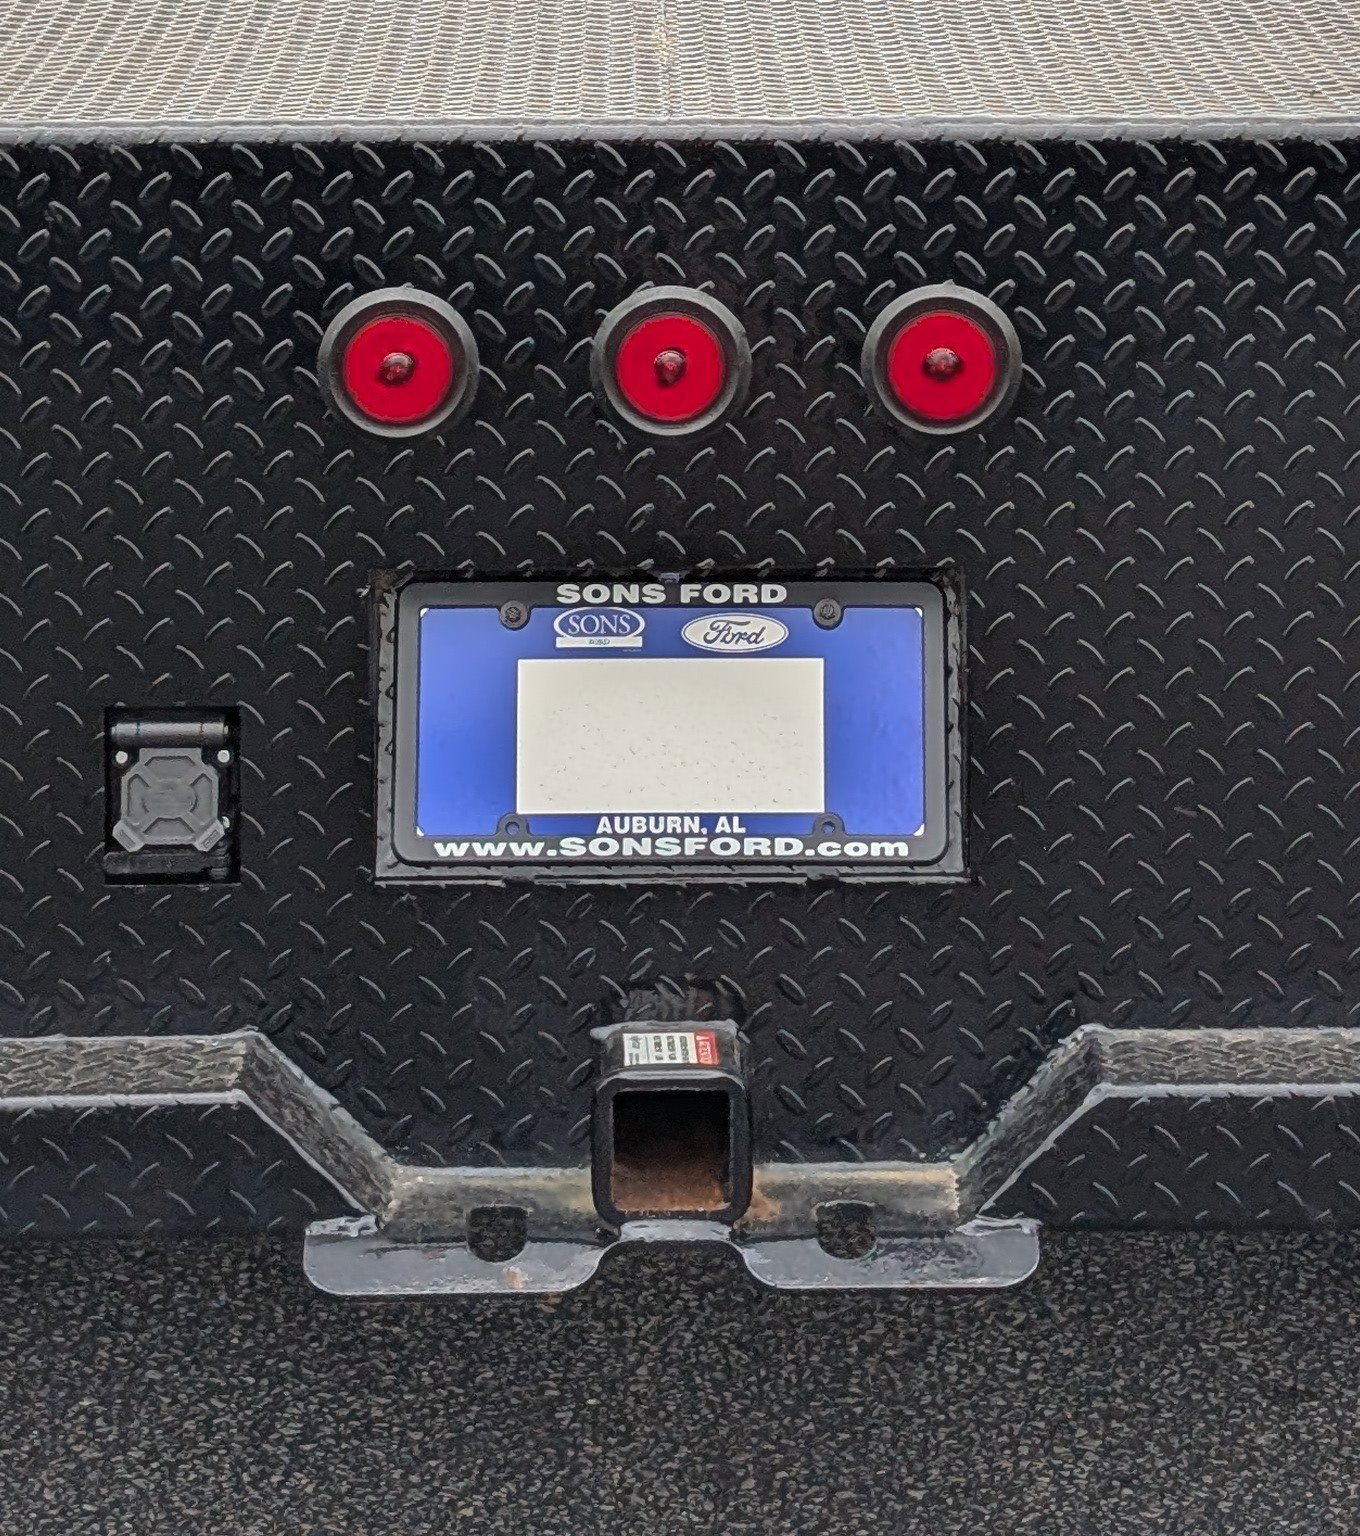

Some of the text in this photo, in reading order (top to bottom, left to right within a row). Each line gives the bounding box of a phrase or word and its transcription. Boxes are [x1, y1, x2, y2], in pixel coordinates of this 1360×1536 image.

[556, 583, 788, 604] SONS FORD
[568, 614, 631, 634] SONS
[702, 619, 765, 646] Ford
[596, 816, 746, 835] AUBURN, AL
[434, 837, 909, 857] www.SONSFORD.com
